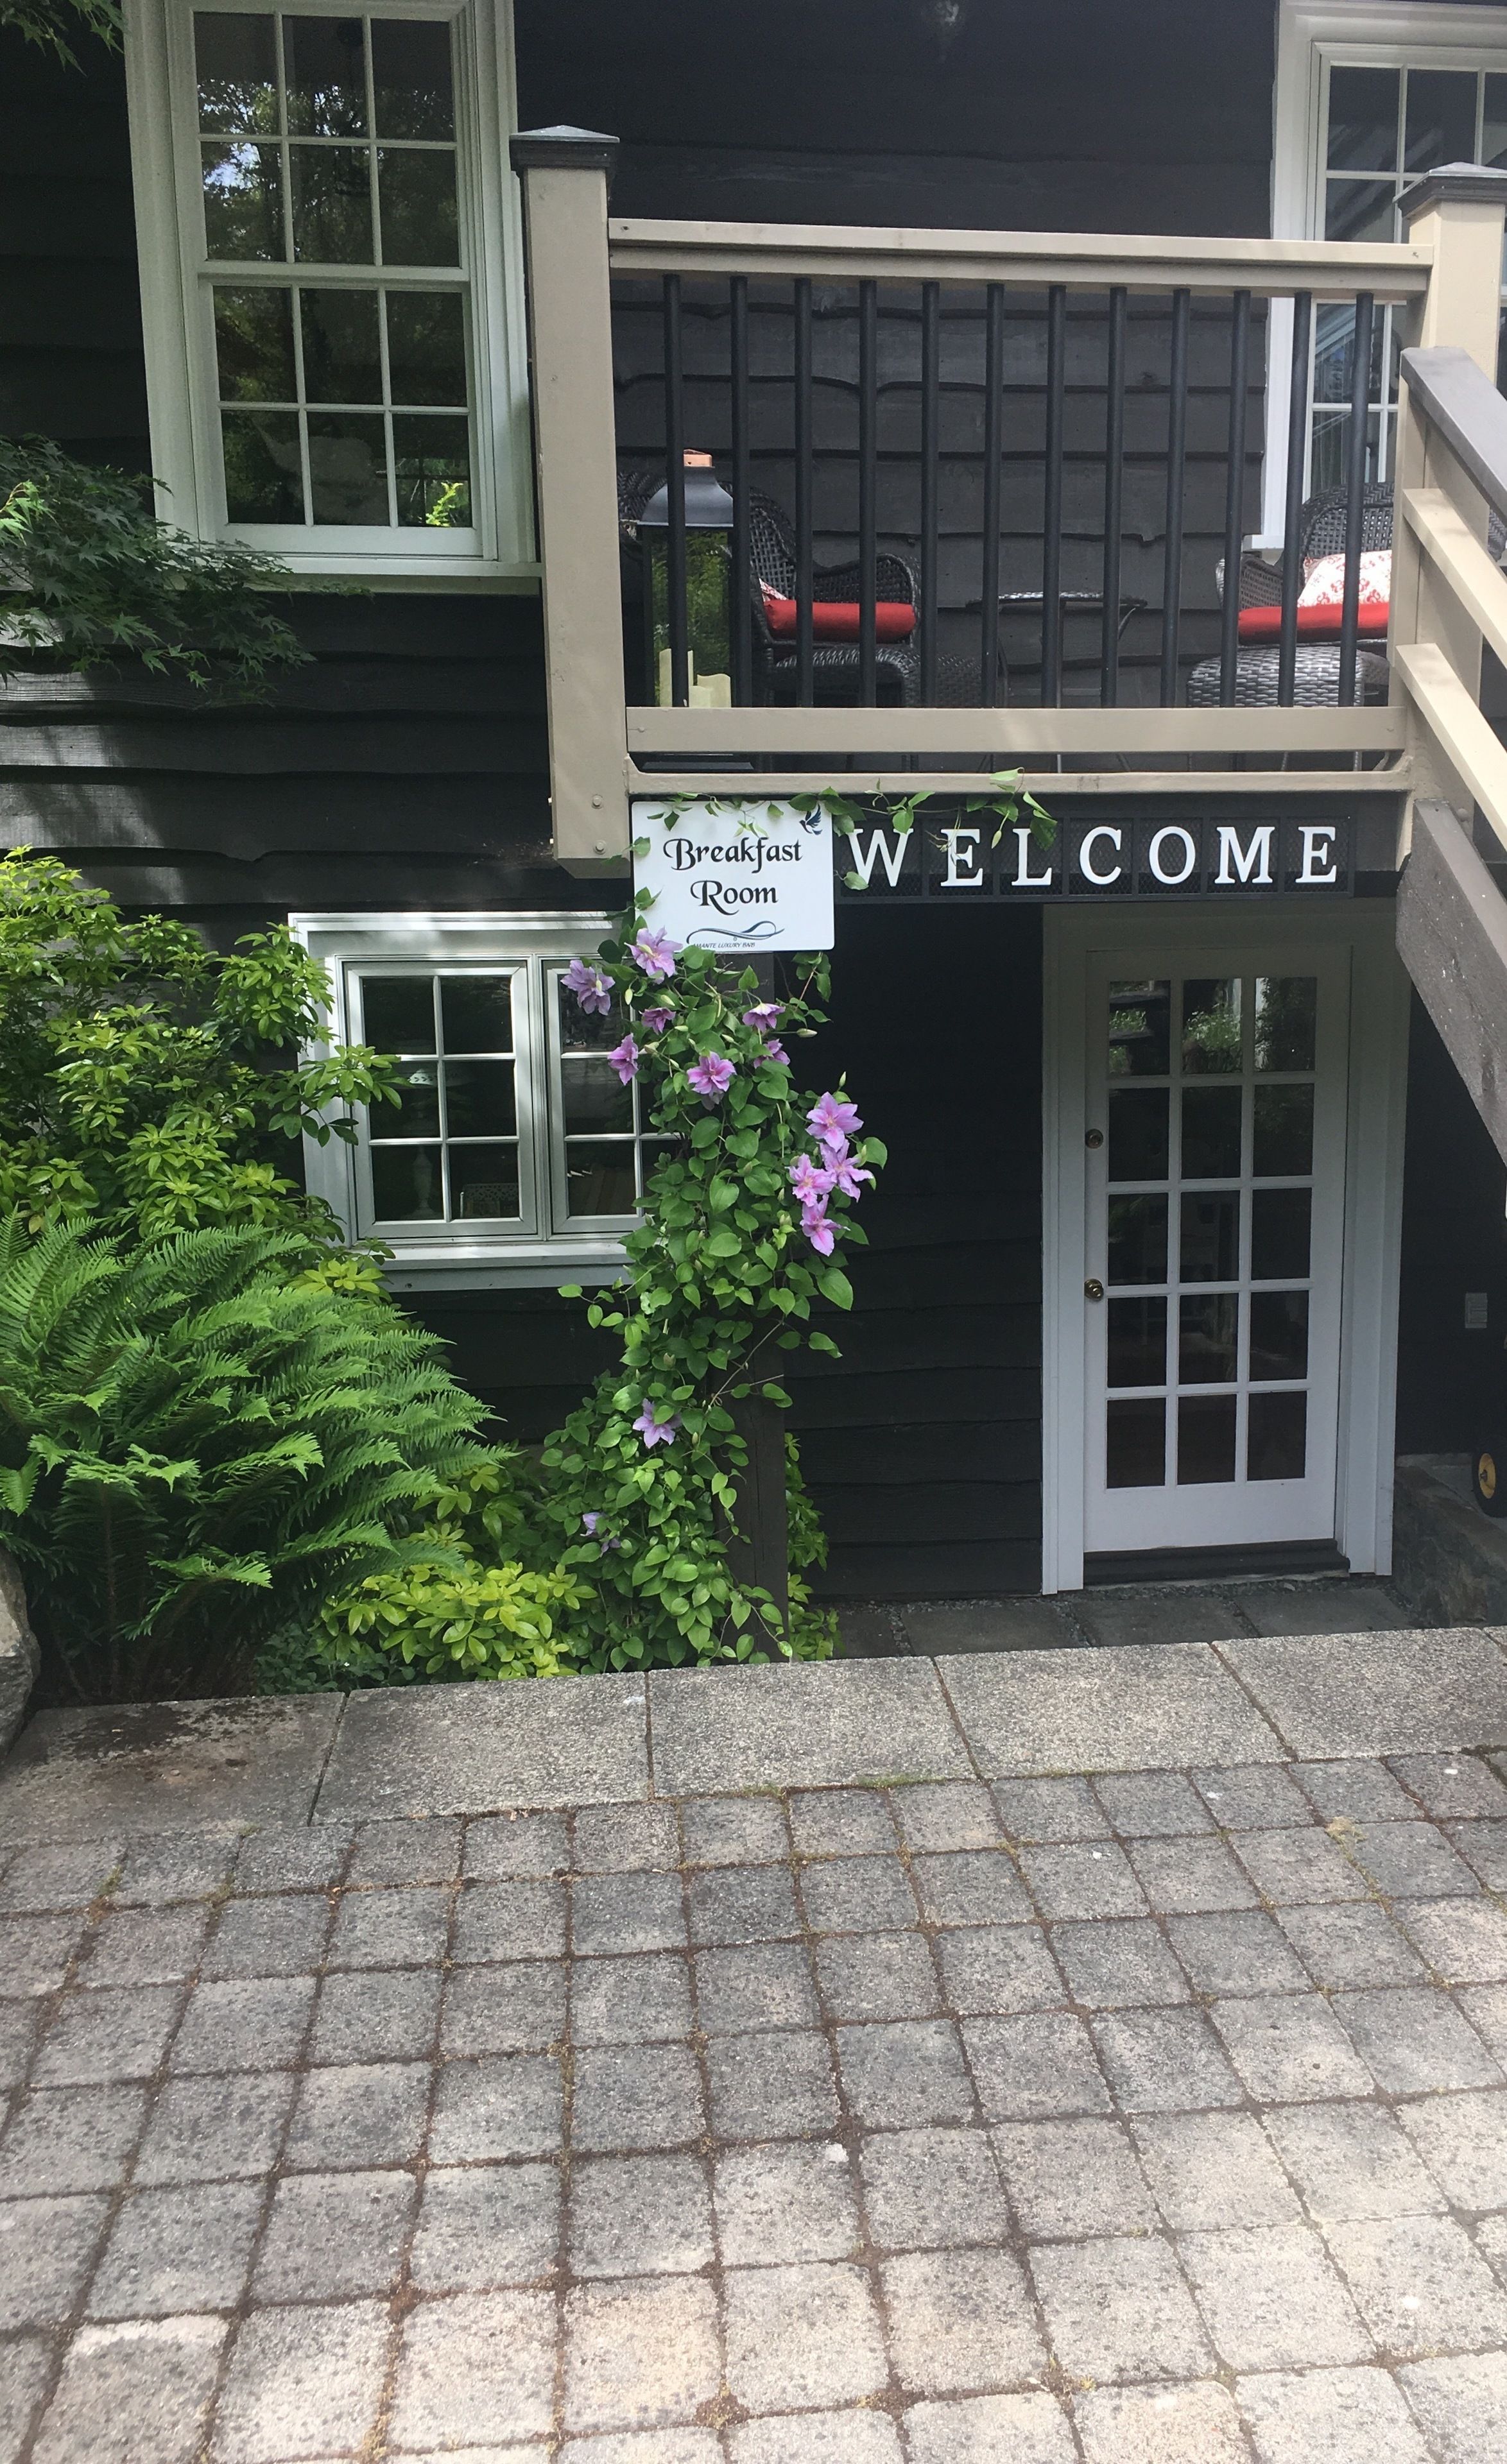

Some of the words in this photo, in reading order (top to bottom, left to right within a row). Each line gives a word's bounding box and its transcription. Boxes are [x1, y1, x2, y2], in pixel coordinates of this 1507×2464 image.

[663, 837, 803, 874] Breakfast
[848, 825, 1338, 888] WELCOME
[690, 880, 779, 916] Room
